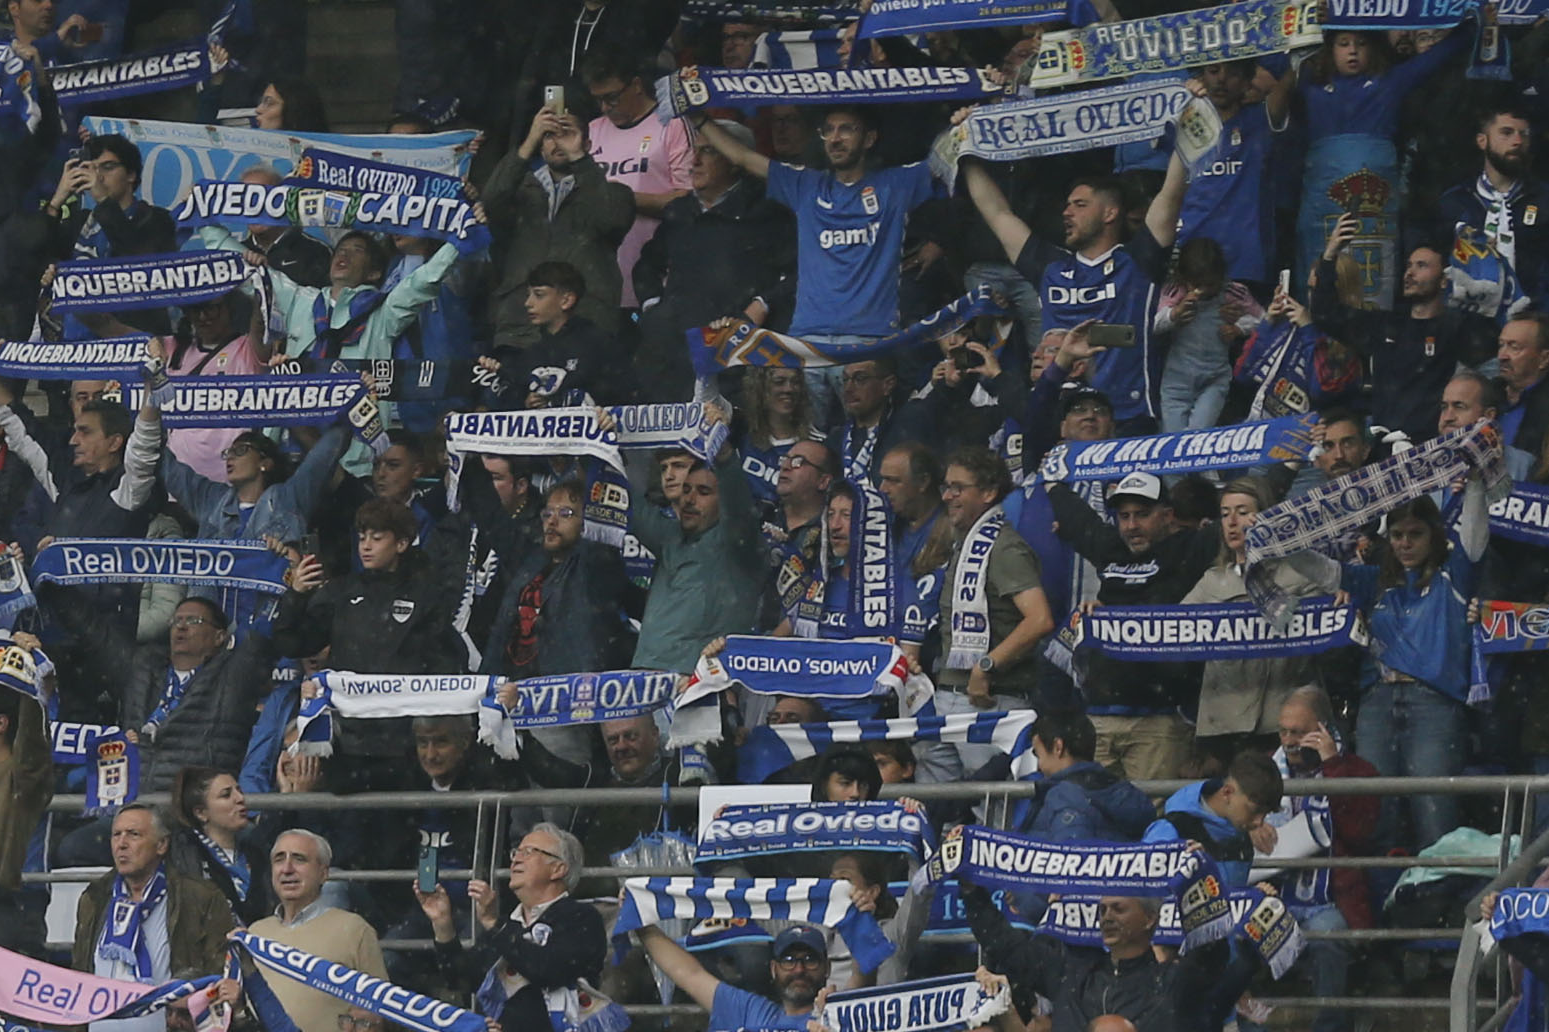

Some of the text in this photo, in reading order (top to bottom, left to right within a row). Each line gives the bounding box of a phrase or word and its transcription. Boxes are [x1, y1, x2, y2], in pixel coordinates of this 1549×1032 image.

[1096, 23, 1151, 43] REAL
[711, 67, 968, 97] INQUEBRANTABLES
[975, 92, 1192, 150] REAL OVIEDO
[318, 160, 353, 188] Real
[357, 169, 417, 196] OVIEDO
[1047, 284, 1115, 305] DIGI
[1075, 424, 1267, 466] NO HAY TREGUA
[1123, 464, 1133, 474] de
[1135, 461, 1160, 473] Peñas
[1194, 456, 1208, 466] del
[1210, 454, 1229, 465] Real
[65, 548, 235, 576] Real OVIEDO
[1093, 608, 1349, 642] INQUEBRANTABLES
[728, 655, 876, 675] ¡VAMOS, OVIEDO!
[704, 810, 921, 843] Real Oviedo
[970, 838, 1199, 879] INQUEBRANTABLES
[16, 968, 82, 1012] Real
[327, 962, 465, 1028] OVIEDO
